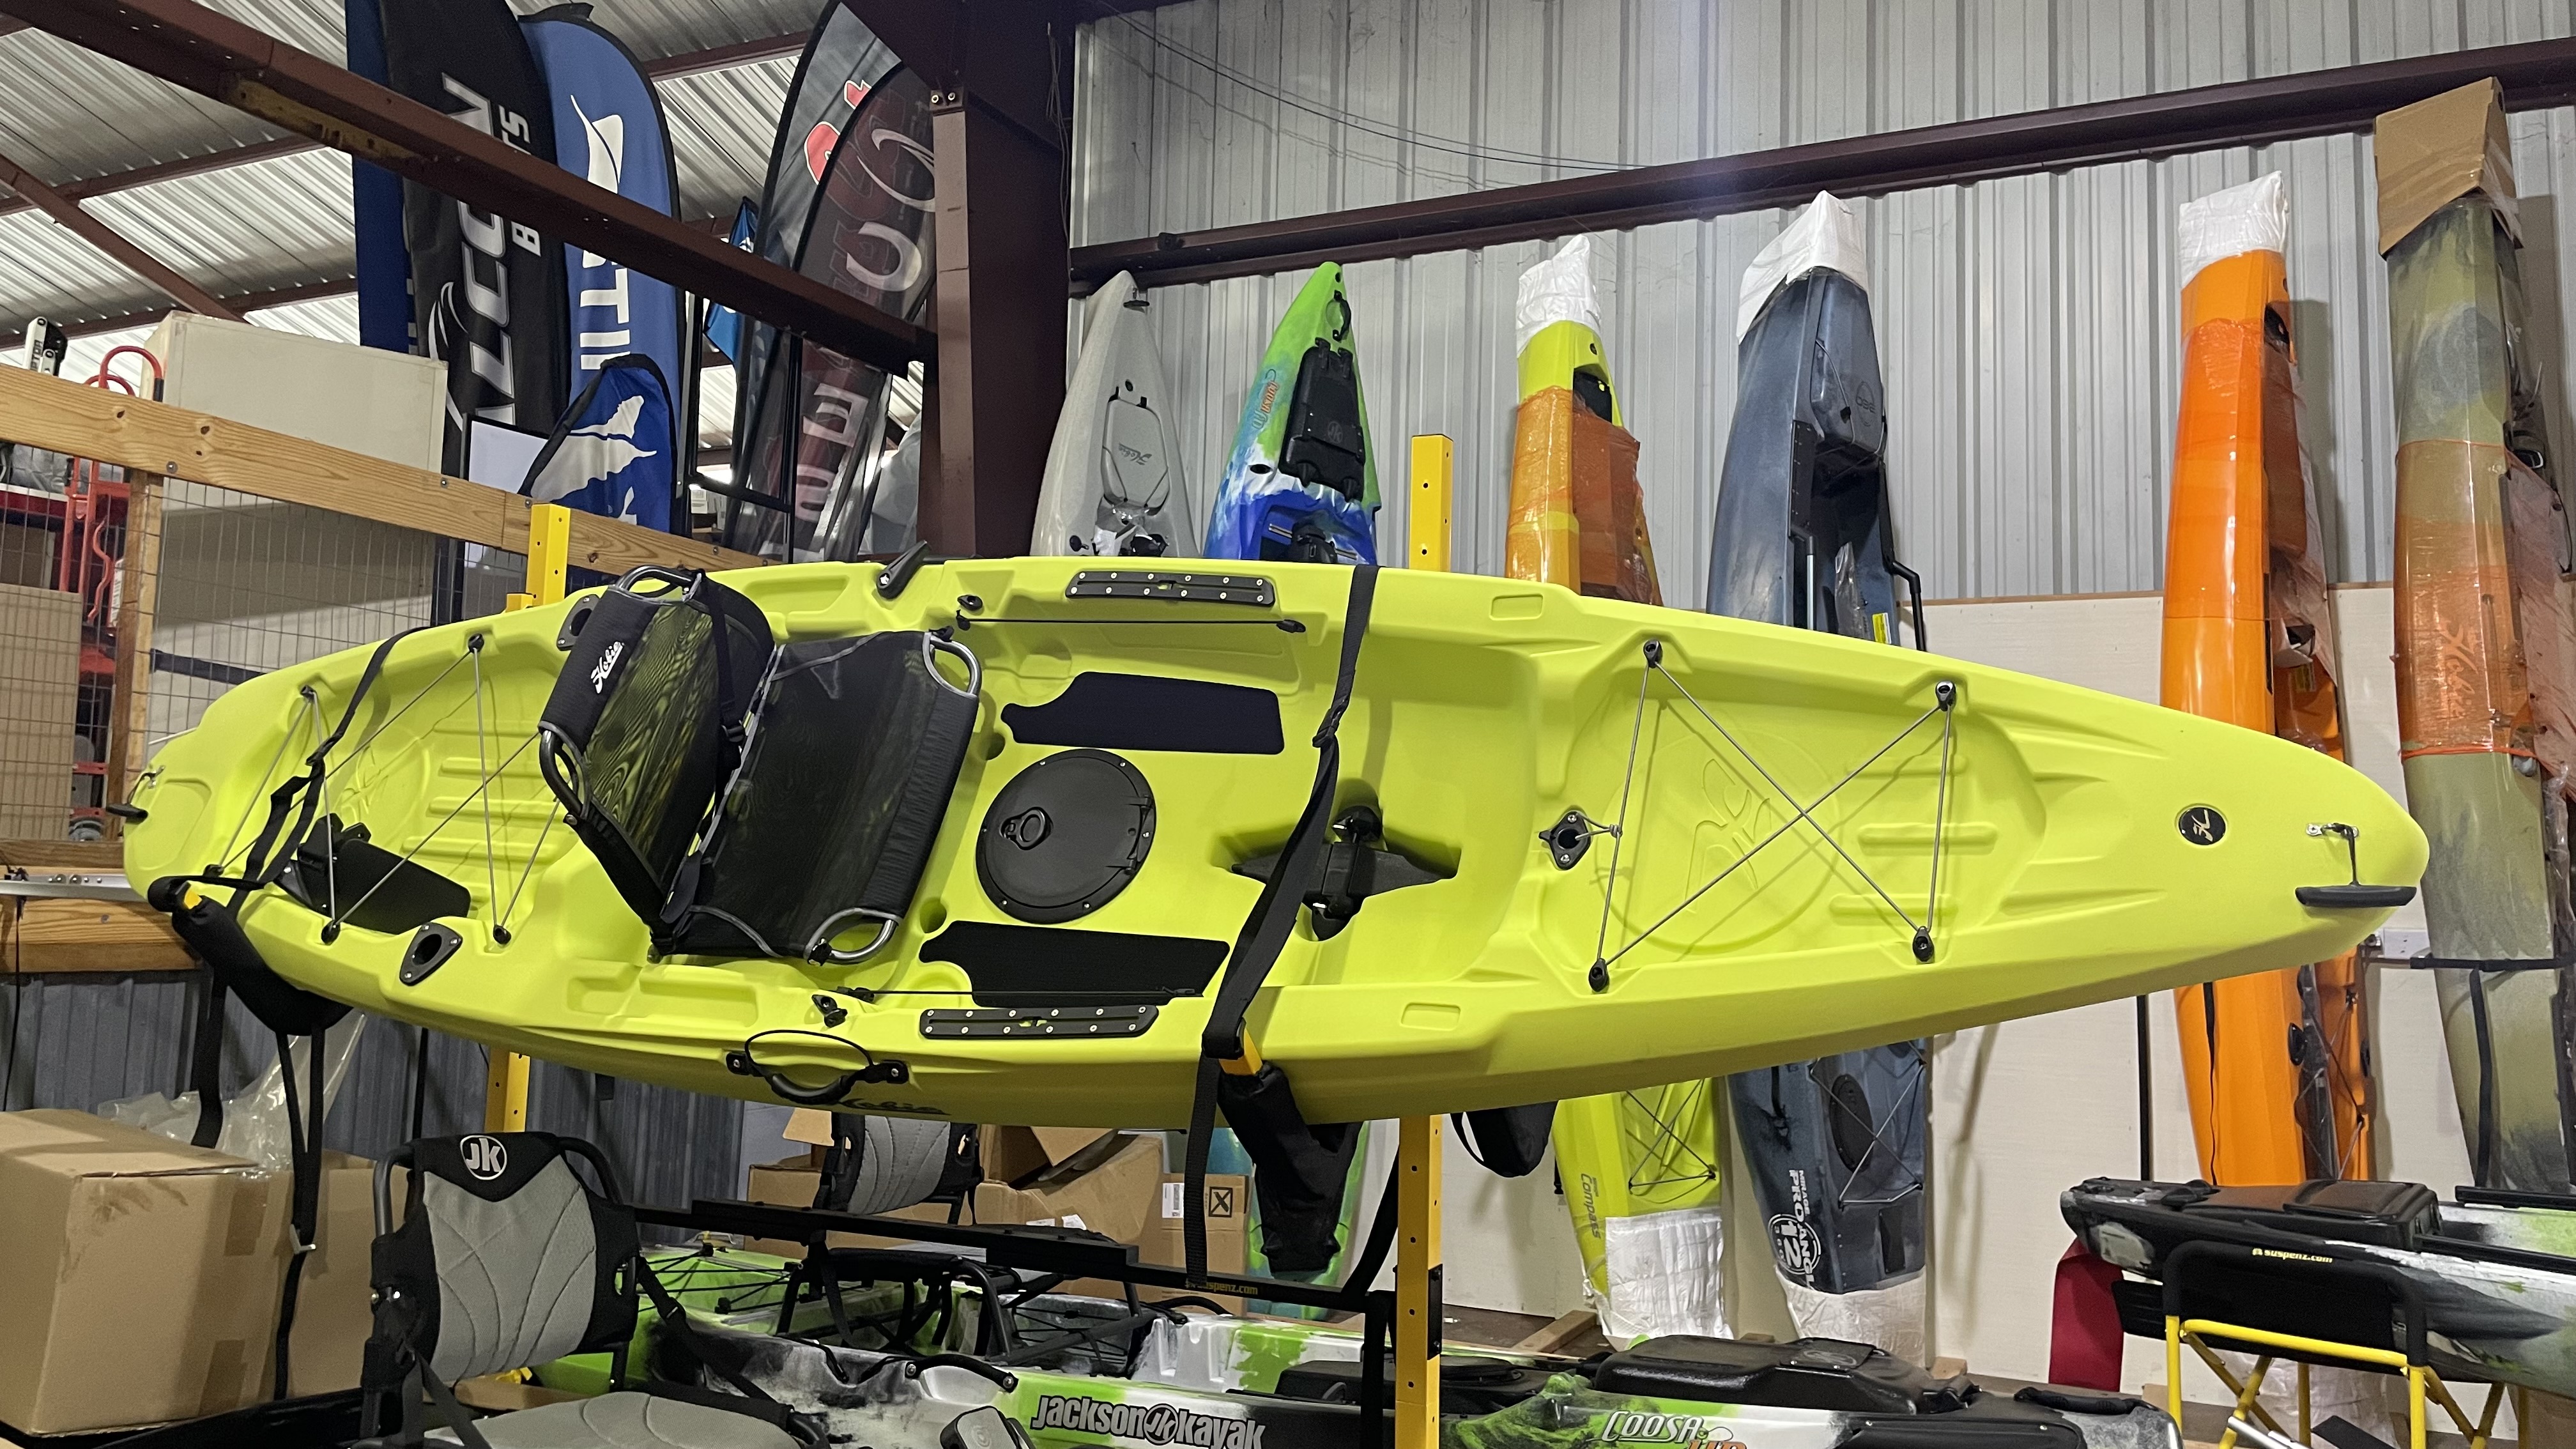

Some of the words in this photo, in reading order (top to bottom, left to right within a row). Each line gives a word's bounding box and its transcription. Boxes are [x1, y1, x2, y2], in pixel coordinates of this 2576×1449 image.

[590, 641, 624, 694] Hobie
[1789, 1170, 1804, 1222] PRO
[1798, 1170, 1811, 1215] MIRAGE
[1781, 1221, 1802, 1268] 12
[2264, 1249, 2333, 1263] suspenz.com
